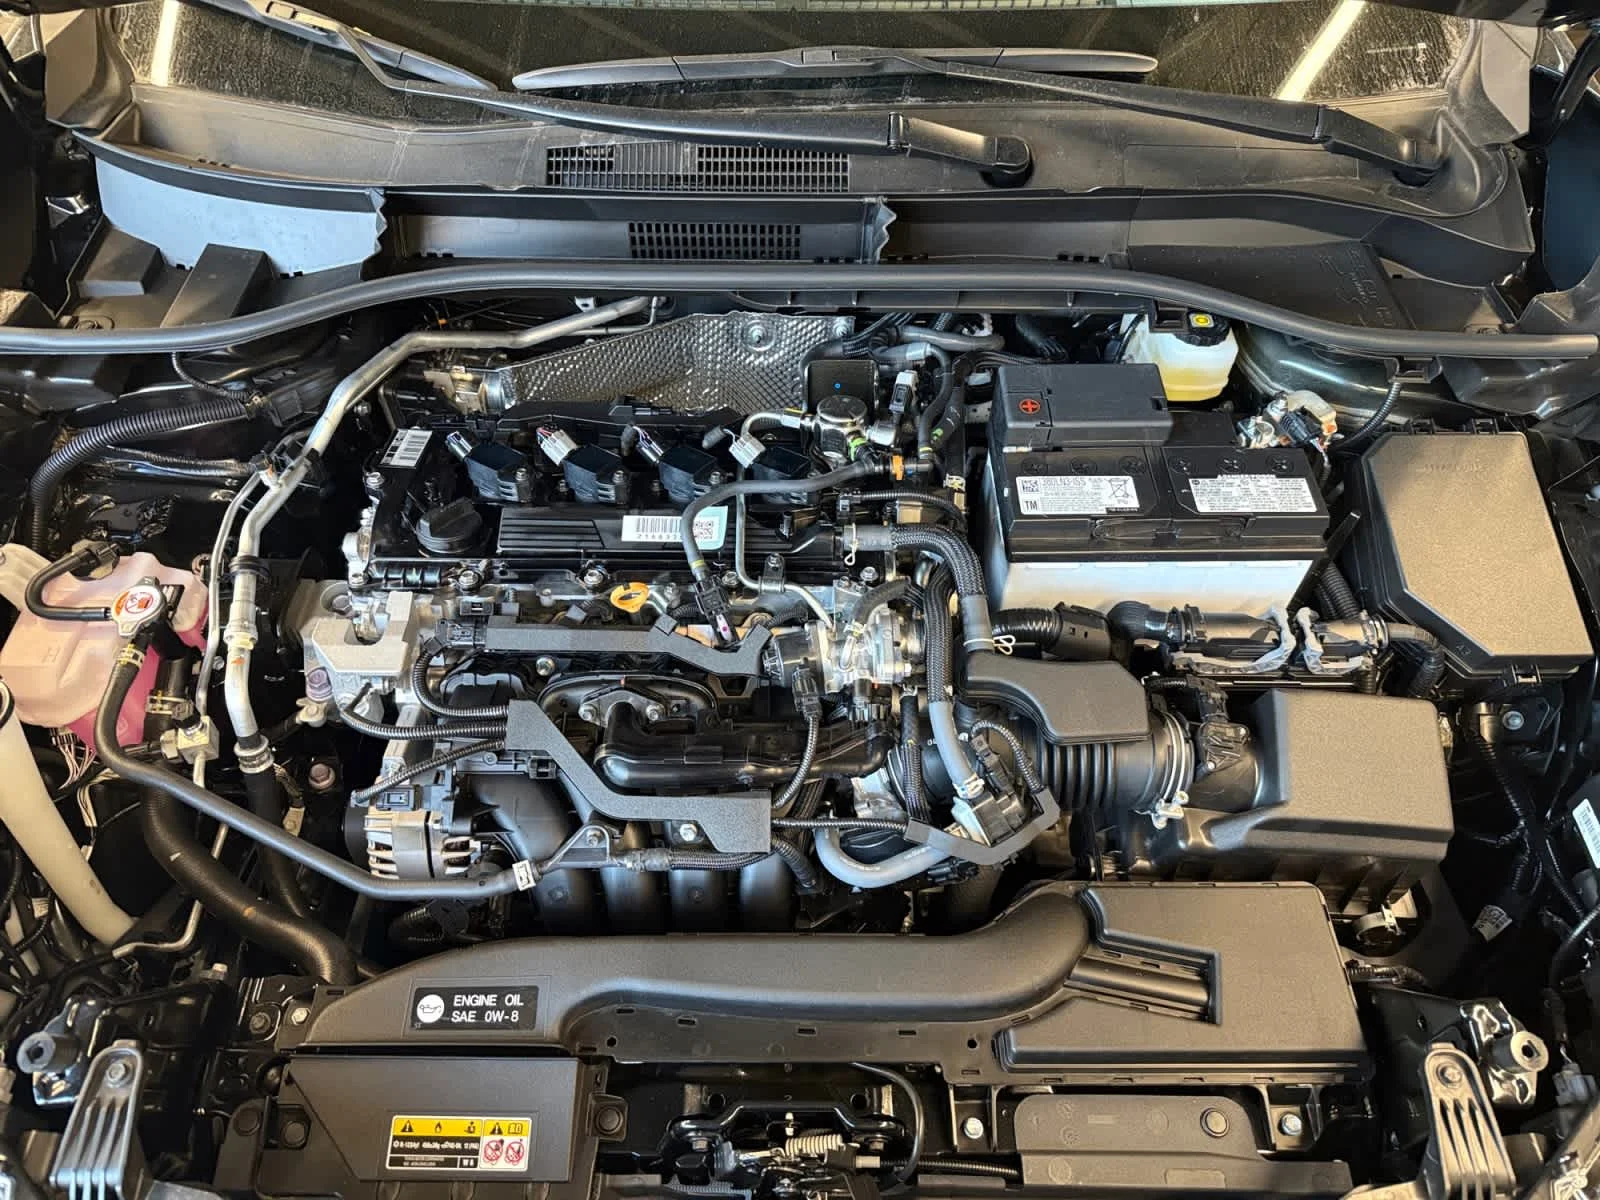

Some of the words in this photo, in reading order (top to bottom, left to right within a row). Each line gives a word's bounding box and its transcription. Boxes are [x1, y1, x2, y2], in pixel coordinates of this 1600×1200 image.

[1024, 500, 1038, 511] TM
[453, 994, 498, 1007] ENGINE
[504, 994, 524, 1006] OIL
[451, 1010, 477, 1023] SAE
[484, 1010, 519, 1023] 0W-8
